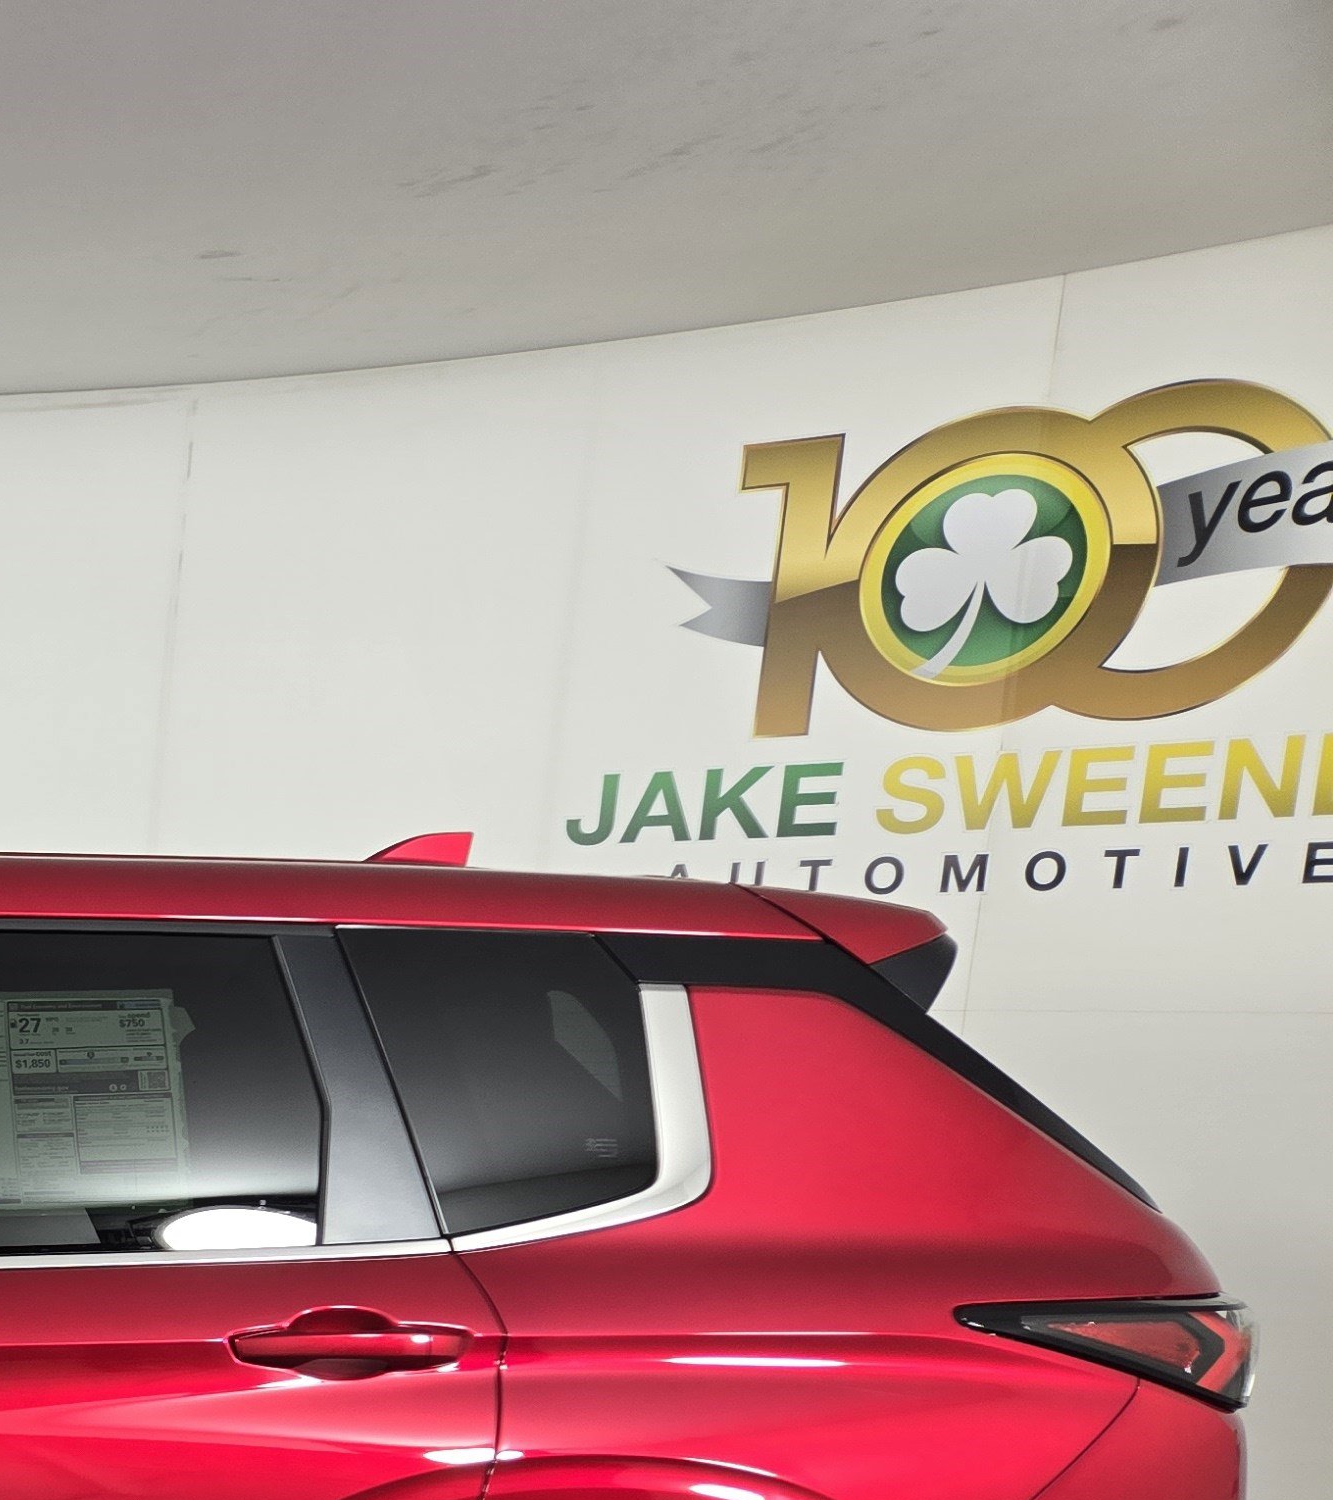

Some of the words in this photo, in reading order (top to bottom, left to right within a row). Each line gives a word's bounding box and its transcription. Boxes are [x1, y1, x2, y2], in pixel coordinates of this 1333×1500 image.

[565, 762, 845, 847] JAKE
[875, 733, 1333, 836] SWEEN
[18, 1017, 42, 1033] 27
[119, 1019, 146, 1029] $750
[15, 1058, 51, 1069] $1,850
